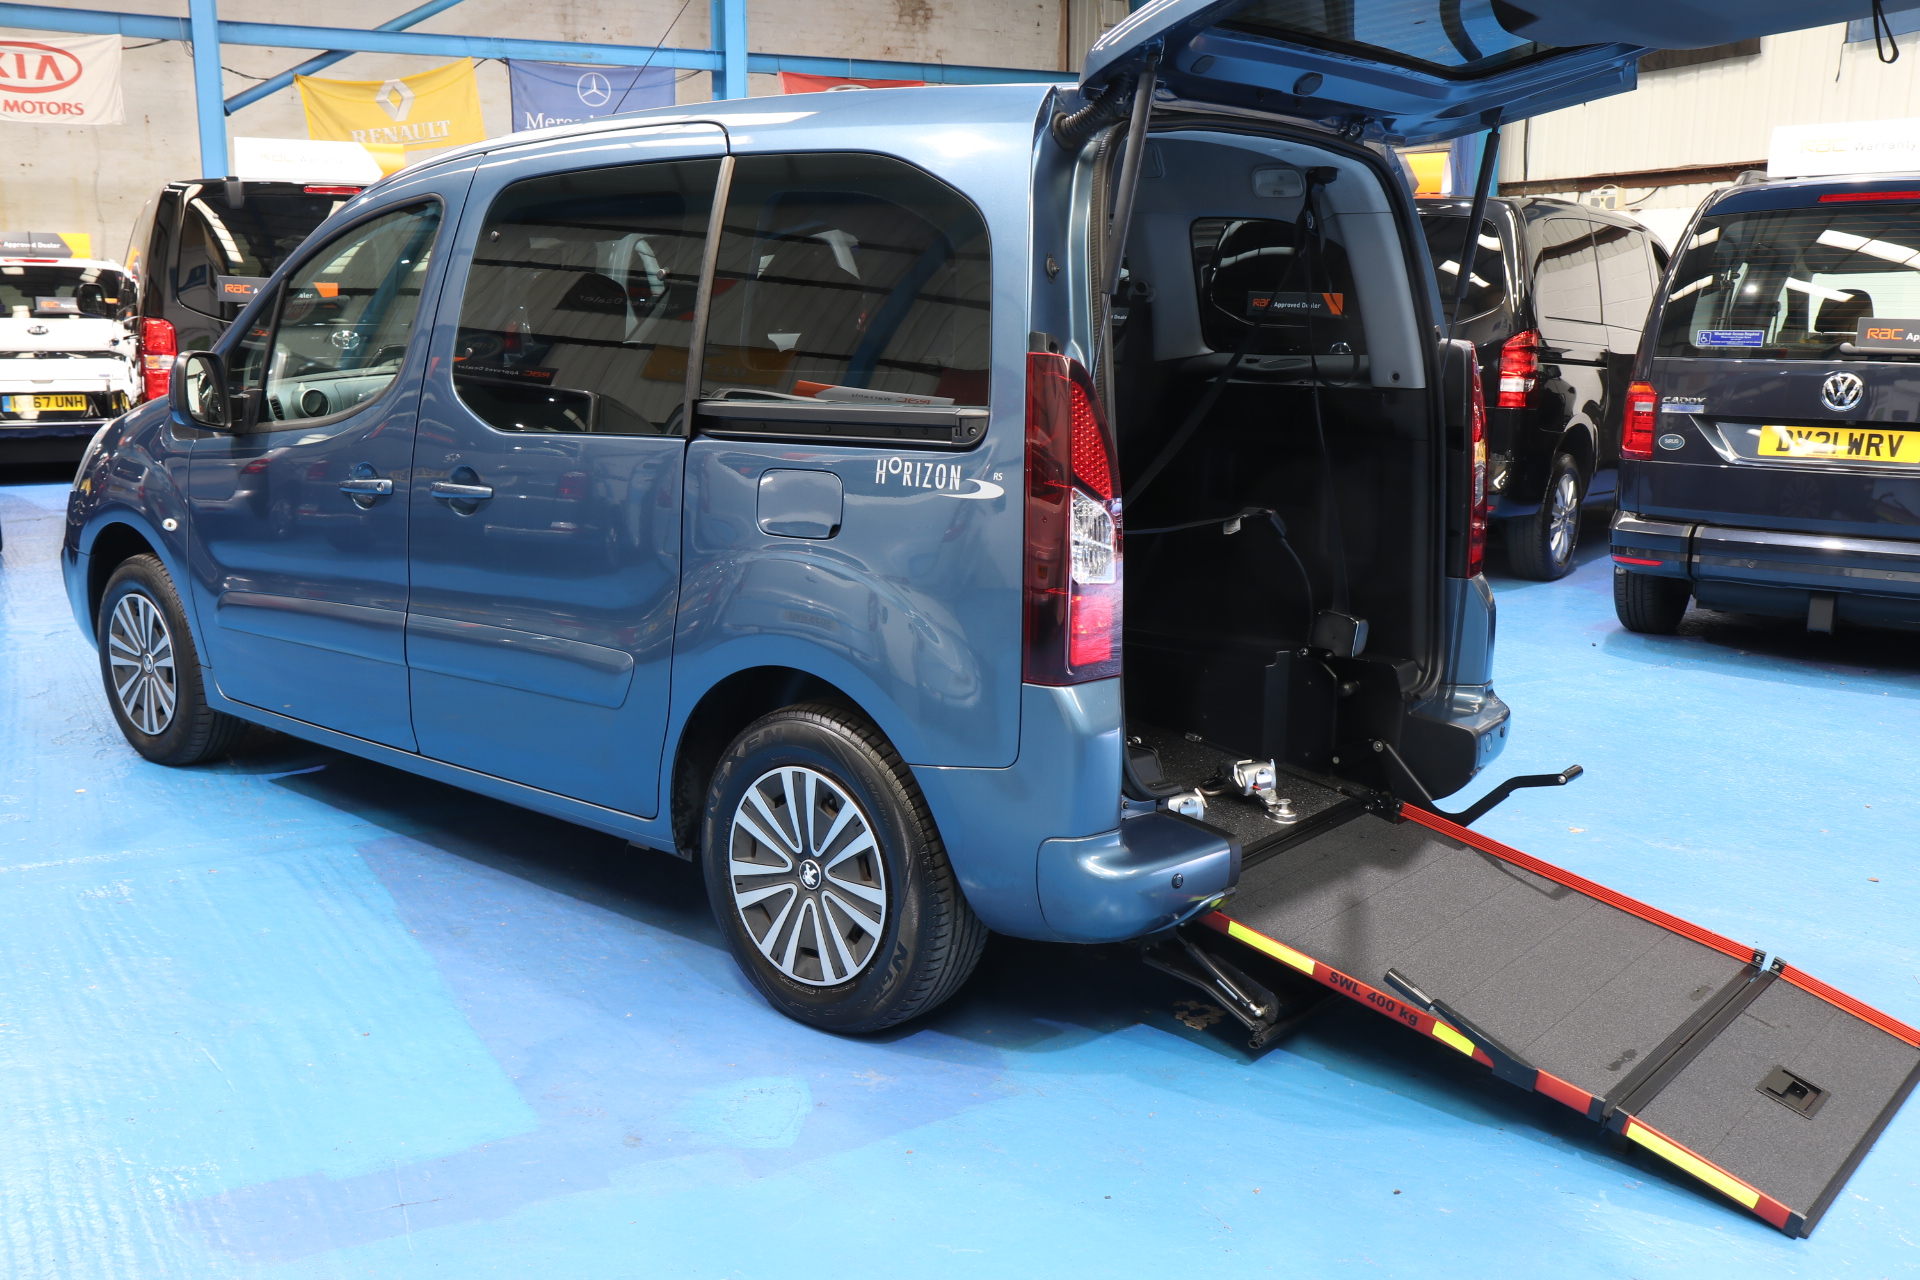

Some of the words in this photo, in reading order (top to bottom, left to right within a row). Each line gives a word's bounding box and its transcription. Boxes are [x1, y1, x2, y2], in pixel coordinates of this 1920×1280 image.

[3, 99, 85, 116] MOTORS
[351, 120, 450, 145] RENAULT
[55, 397, 83, 408] UNH
[1847, 432, 1904, 457] WRV
[875, 457, 961, 490] HORIZON
[993, 472, 1003, 481] RS
[1329, 972, 1361, 996] SWL
[1367, 992, 1396, 1012] 400
[1398, 1007, 1419, 1026] kg
